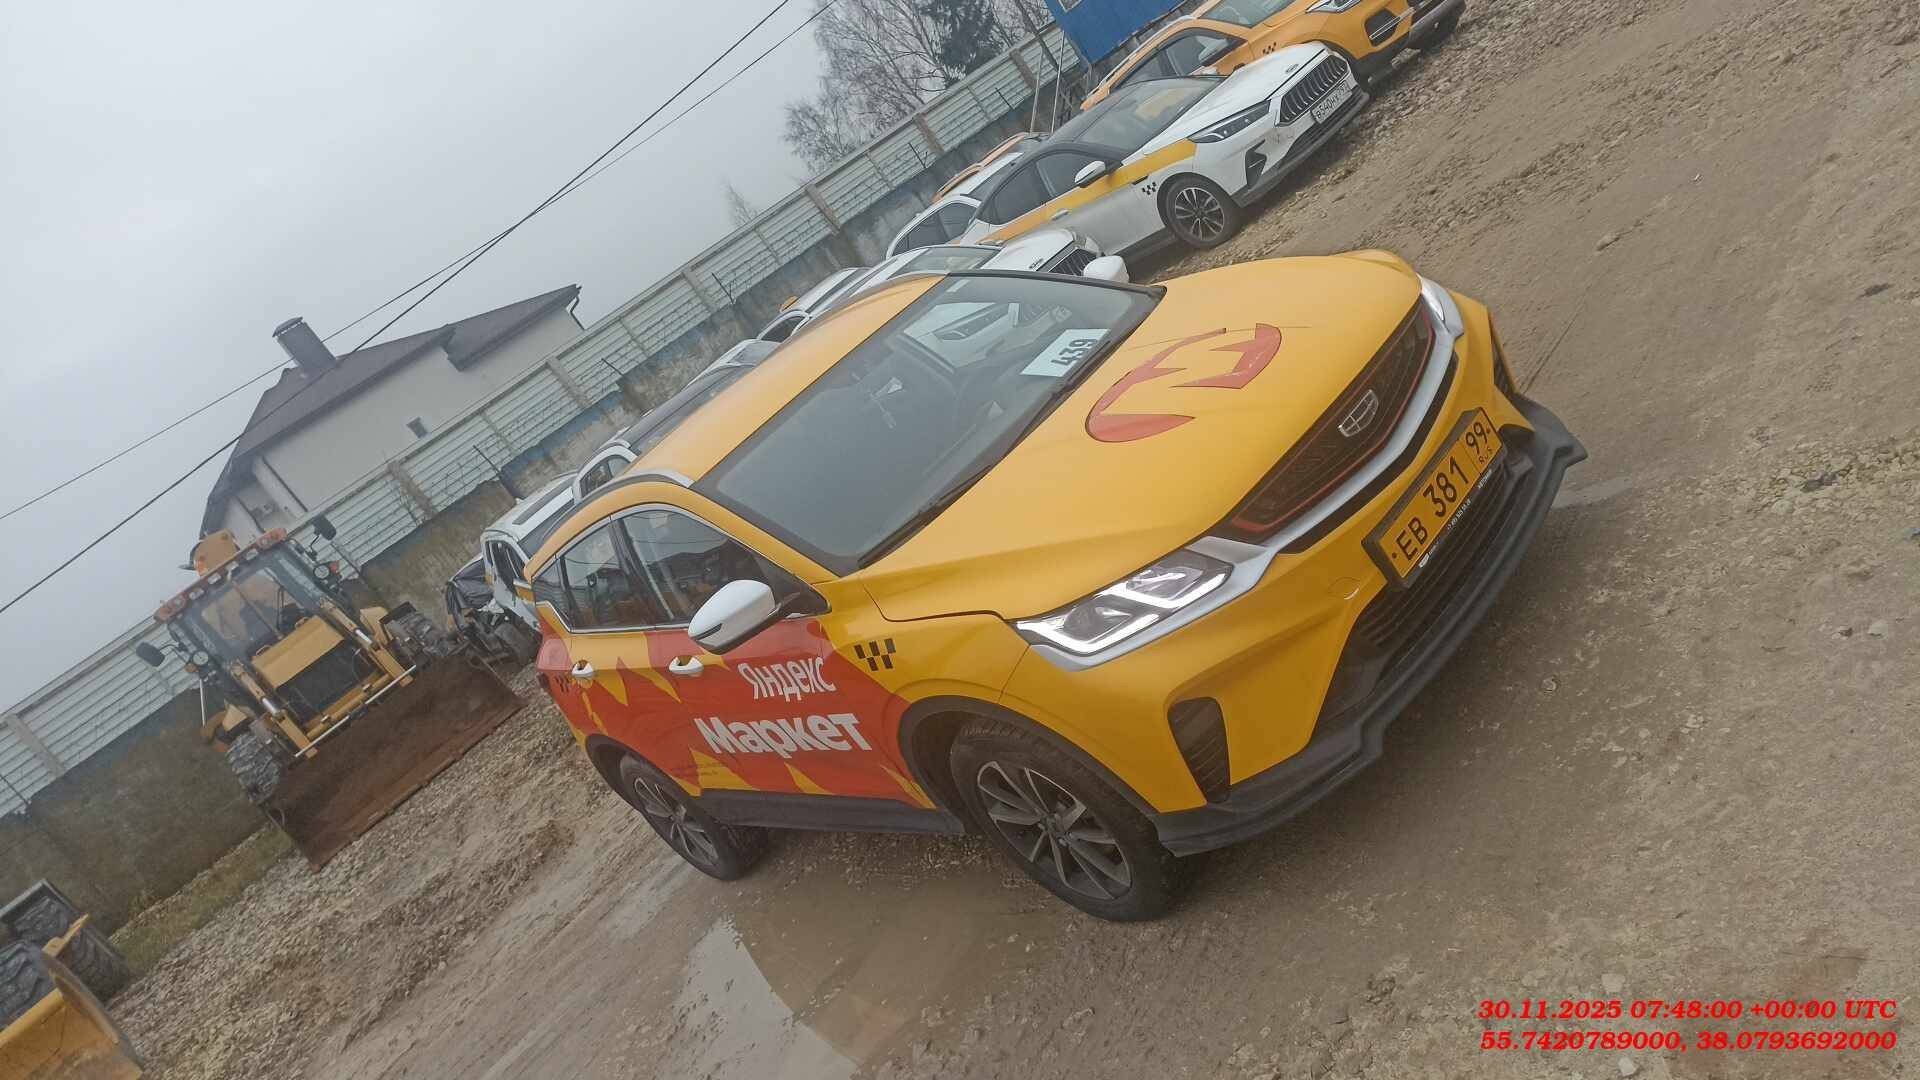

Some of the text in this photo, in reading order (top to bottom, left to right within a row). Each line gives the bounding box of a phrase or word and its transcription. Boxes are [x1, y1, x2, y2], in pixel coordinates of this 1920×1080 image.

[1051, 338, 1097, 366] 439
[1396, 516, 1428, 560] ЕВ
[1423, 456, 1469, 517] 381
[1465, 422, 1488, 454] 99
[737, 656, 837, 702] Яндекс
[693, 713, 873, 759] Маркет
